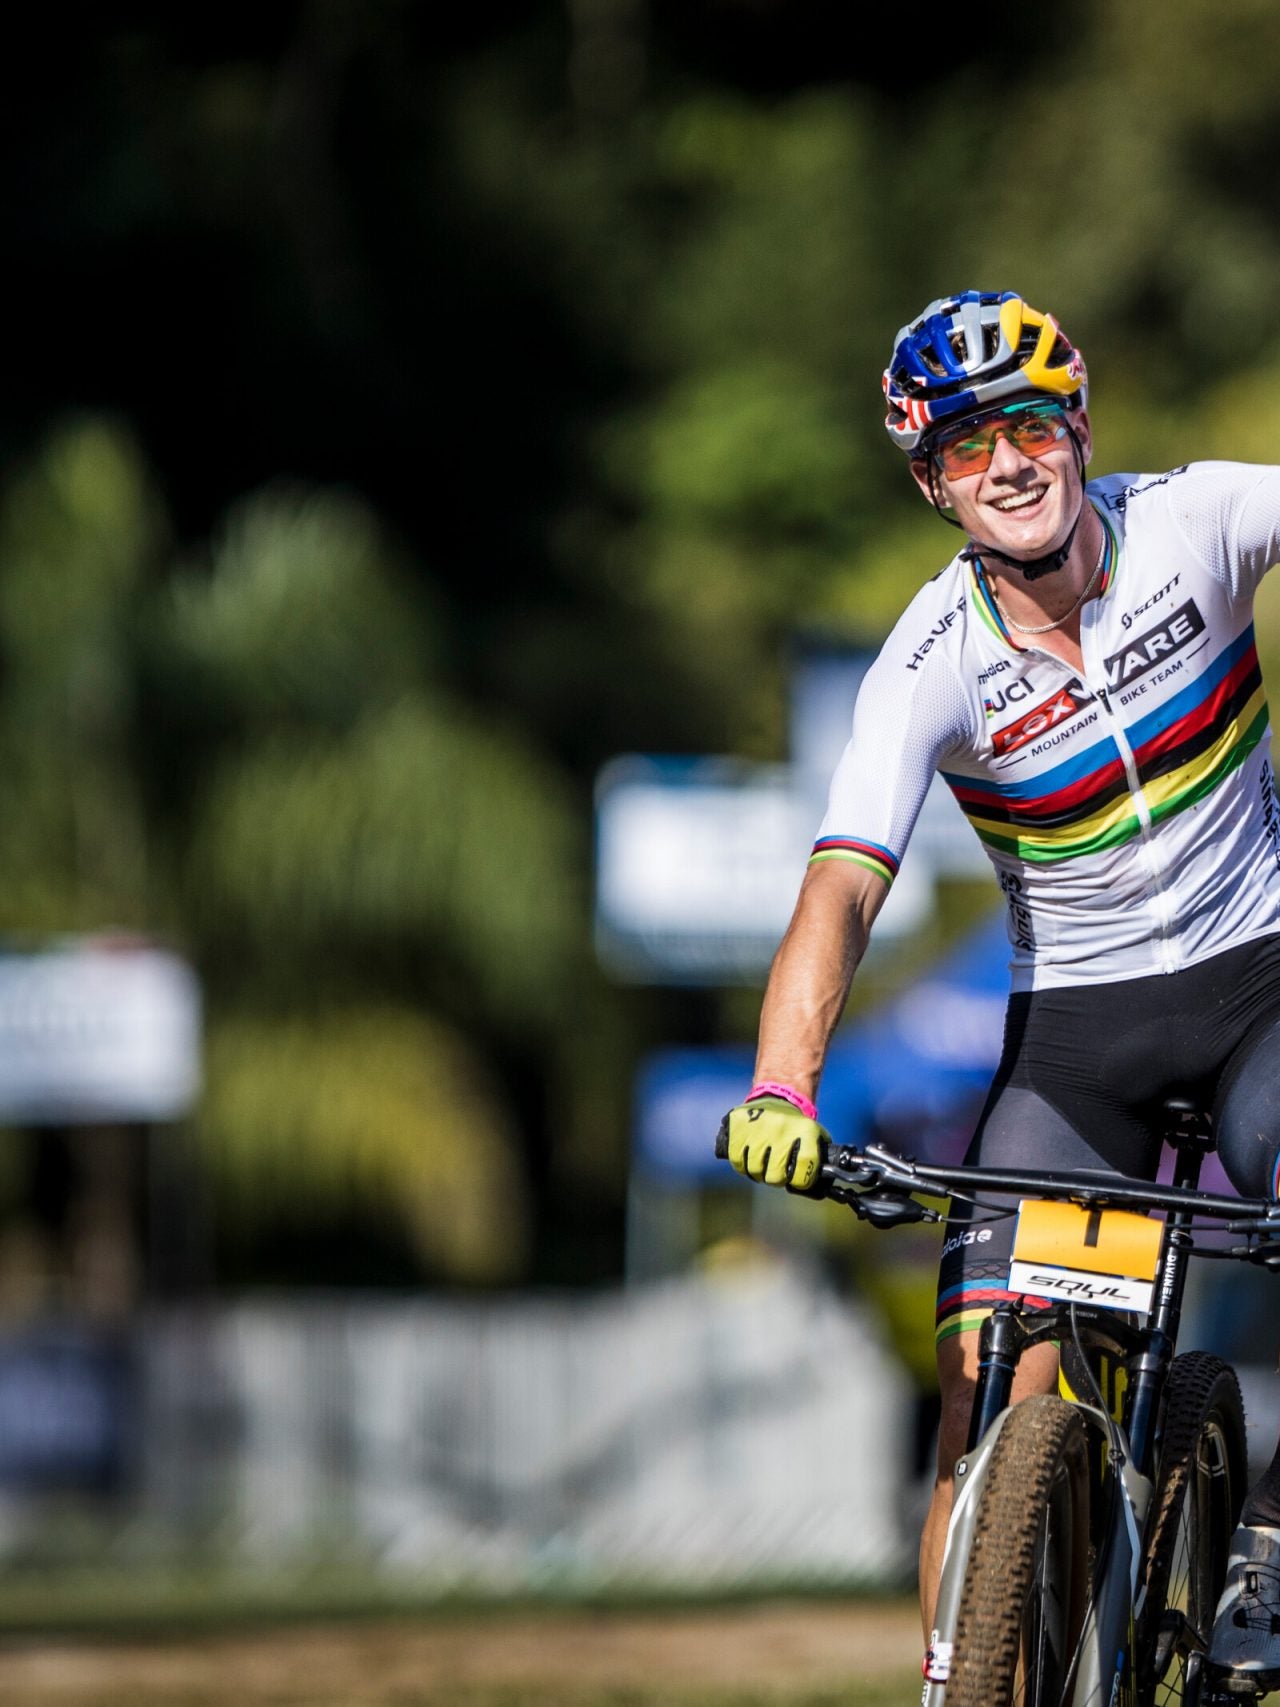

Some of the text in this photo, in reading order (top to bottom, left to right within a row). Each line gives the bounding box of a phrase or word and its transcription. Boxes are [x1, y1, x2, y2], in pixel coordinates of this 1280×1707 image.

[1133, 572, 1180, 616] SCOTT
[989, 677, 1035, 713] UCI
[1031, 660, 1184, 757] MOUNTAIN BIKE TEAM
